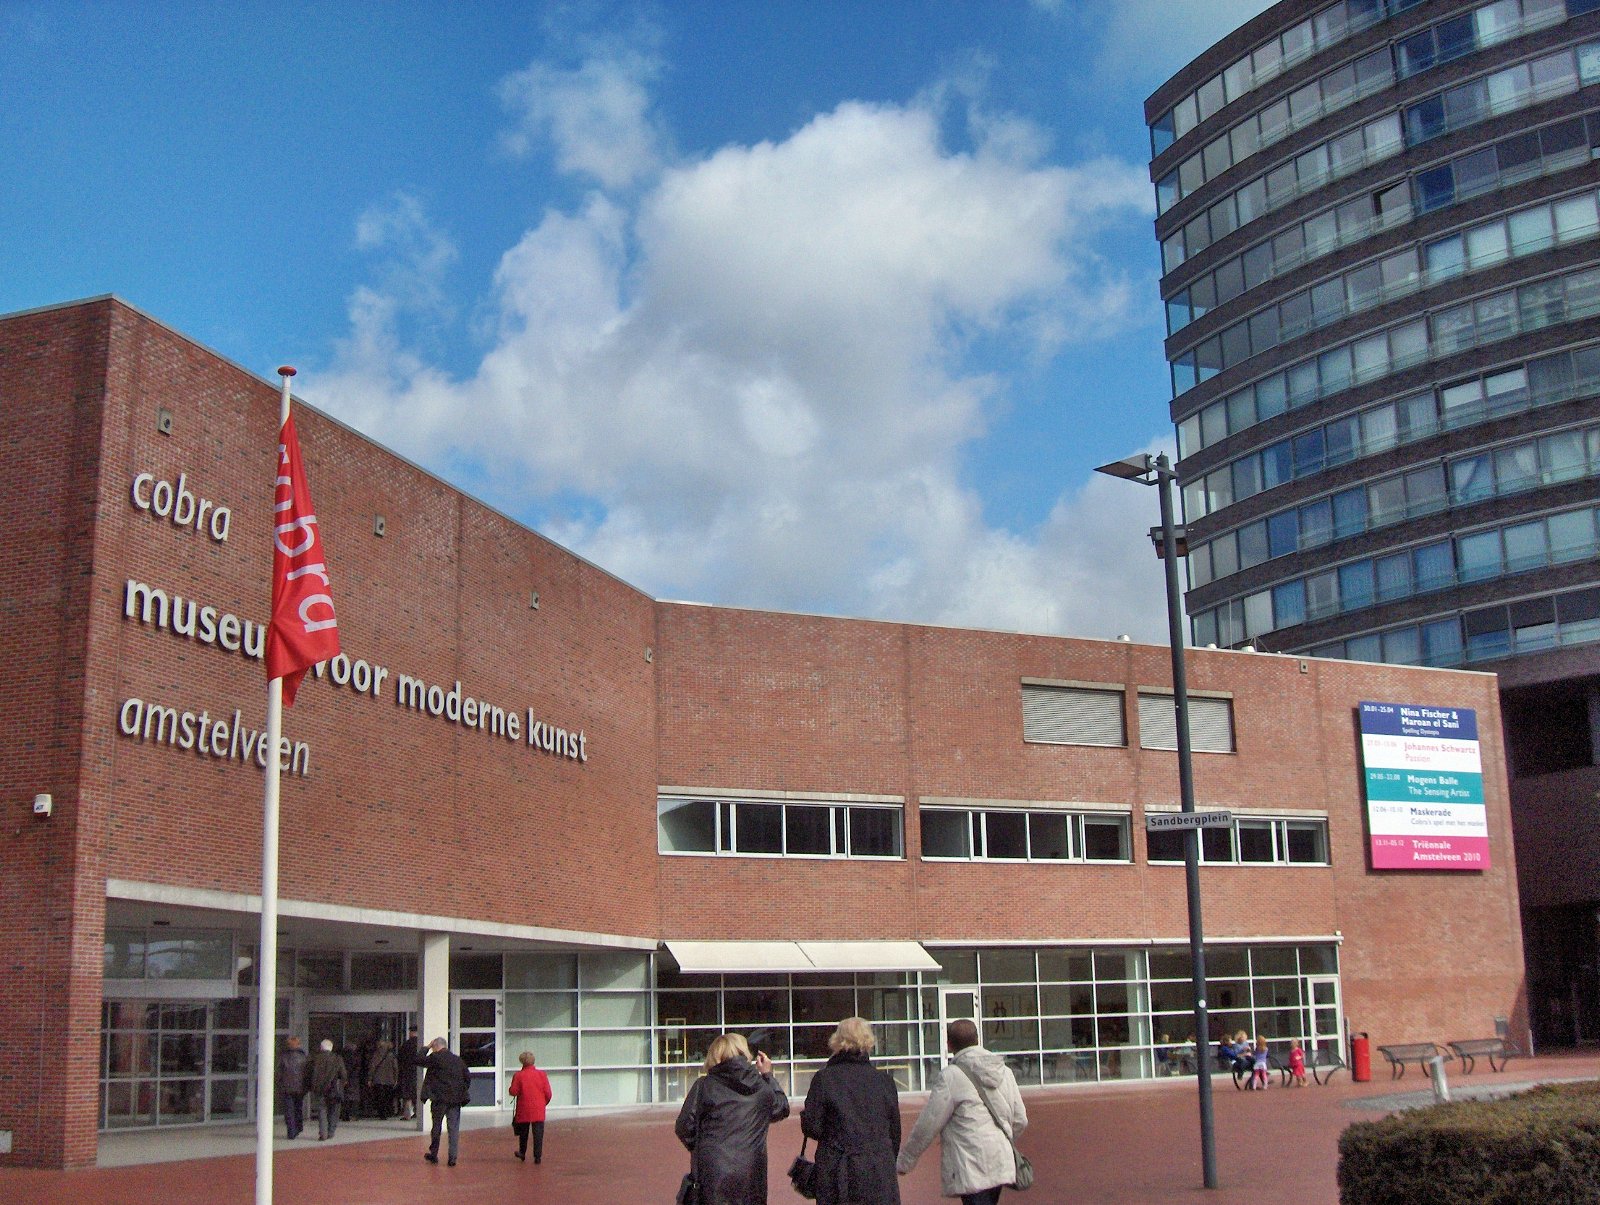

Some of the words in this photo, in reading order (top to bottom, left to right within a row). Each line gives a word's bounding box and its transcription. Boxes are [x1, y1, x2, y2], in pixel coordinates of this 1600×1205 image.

[132, 472, 232, 541] cobra
[274, 443, 338, 633] obra
[125, 579, 265, 659] museu
[398, 673, 520, 740] moderne
[528, 707, 588, 762] kunst
[1400, 707, 1420, 717] Nina
[1421, 708, 1450, 719] Fischer
[1451, 711, 1458, 720] &
[1401, 717, 1432, 727] Maroan
[1442, 720, 1459, 729] Sani
[120, 697, 310, 775] amstelveen
[1404, 742, 1439, 752] Johannes
[1441, 744, 1476, 754] Schwartz
[1407, 775, 1437, 786] Mogens
[1438, 776, 1458, 785] Balle
[1408, 786, 1422, 795] The
[1423, 787, 1450, 798] Sensing
[1410, 807, 1452, 817] Maskerade
[1151, 813, 1228, 826] Sandbergplein
[1413, 852, 1461, 862] Amstelveen
[1463, 852, 1481, 862] 2010
